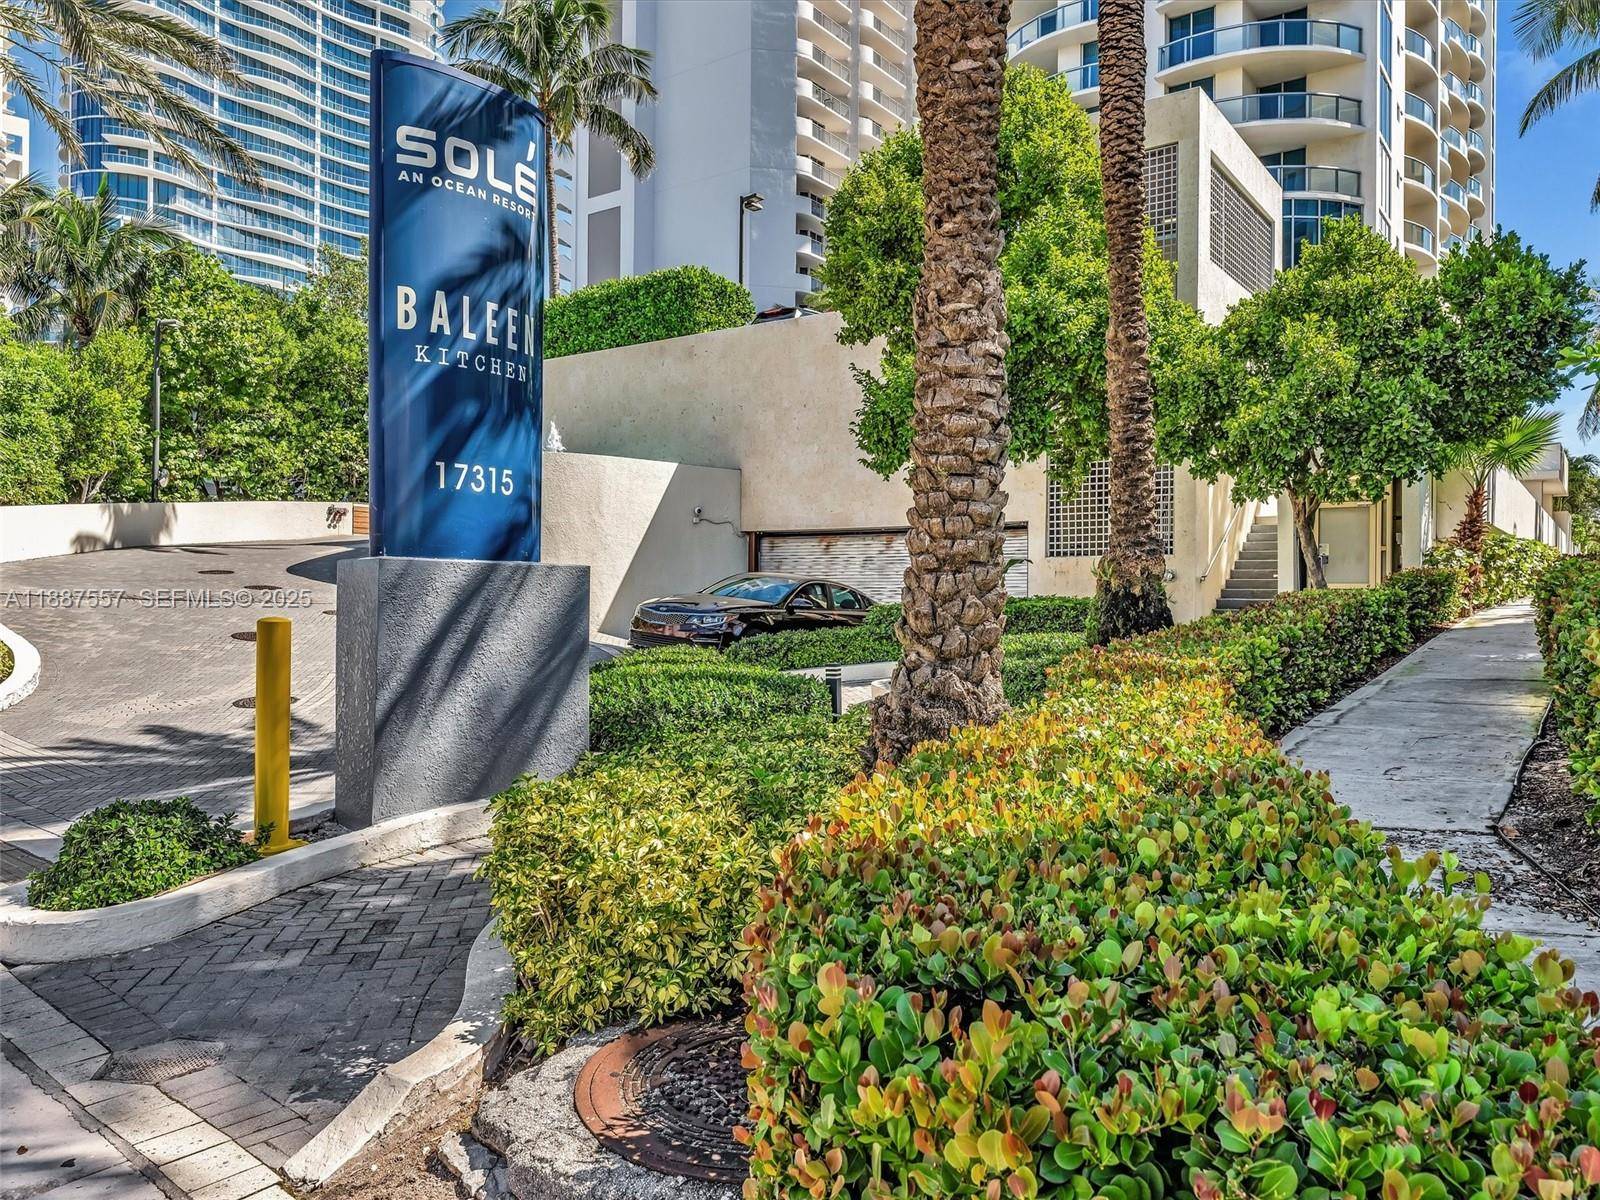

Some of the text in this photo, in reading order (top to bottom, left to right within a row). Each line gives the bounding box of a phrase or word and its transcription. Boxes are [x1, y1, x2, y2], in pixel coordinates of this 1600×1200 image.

[396, 125, 536, 207] SOLÉ
[398, 170, 536, 222] AN OCEAN RESORT
[396, 285, 535, 357] BALEEN
[414, 344, 527, 382] KITCHEN
[435, 461, 514, 496] 17315
